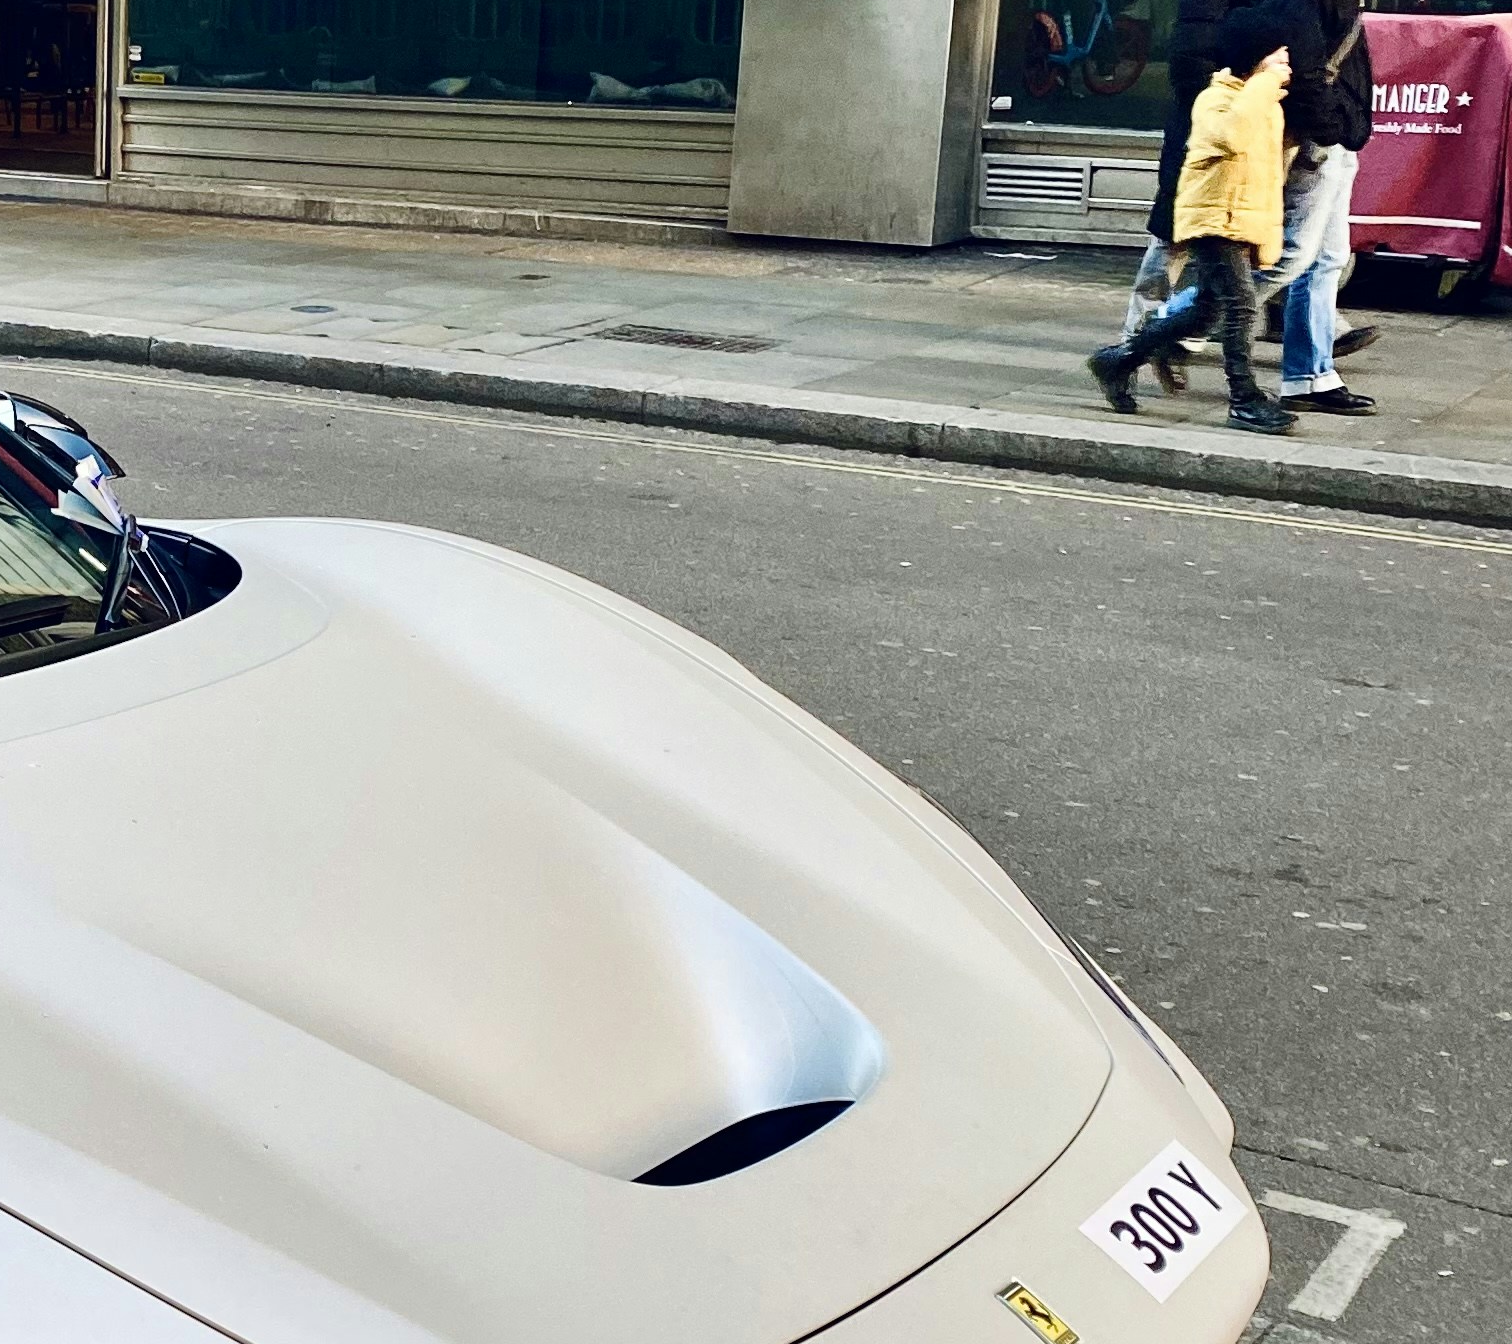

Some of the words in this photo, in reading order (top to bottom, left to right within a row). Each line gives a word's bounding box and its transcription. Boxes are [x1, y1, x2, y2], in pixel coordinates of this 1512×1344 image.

[1372, 83, 1450, 114] MANGER
[1404, 122, 1433, 134] Made
[1435, 123, 1462, 135] Food
[1109, 1186, 1201, 1274] 300
[1167, 1160, 1222, 1212] Y
